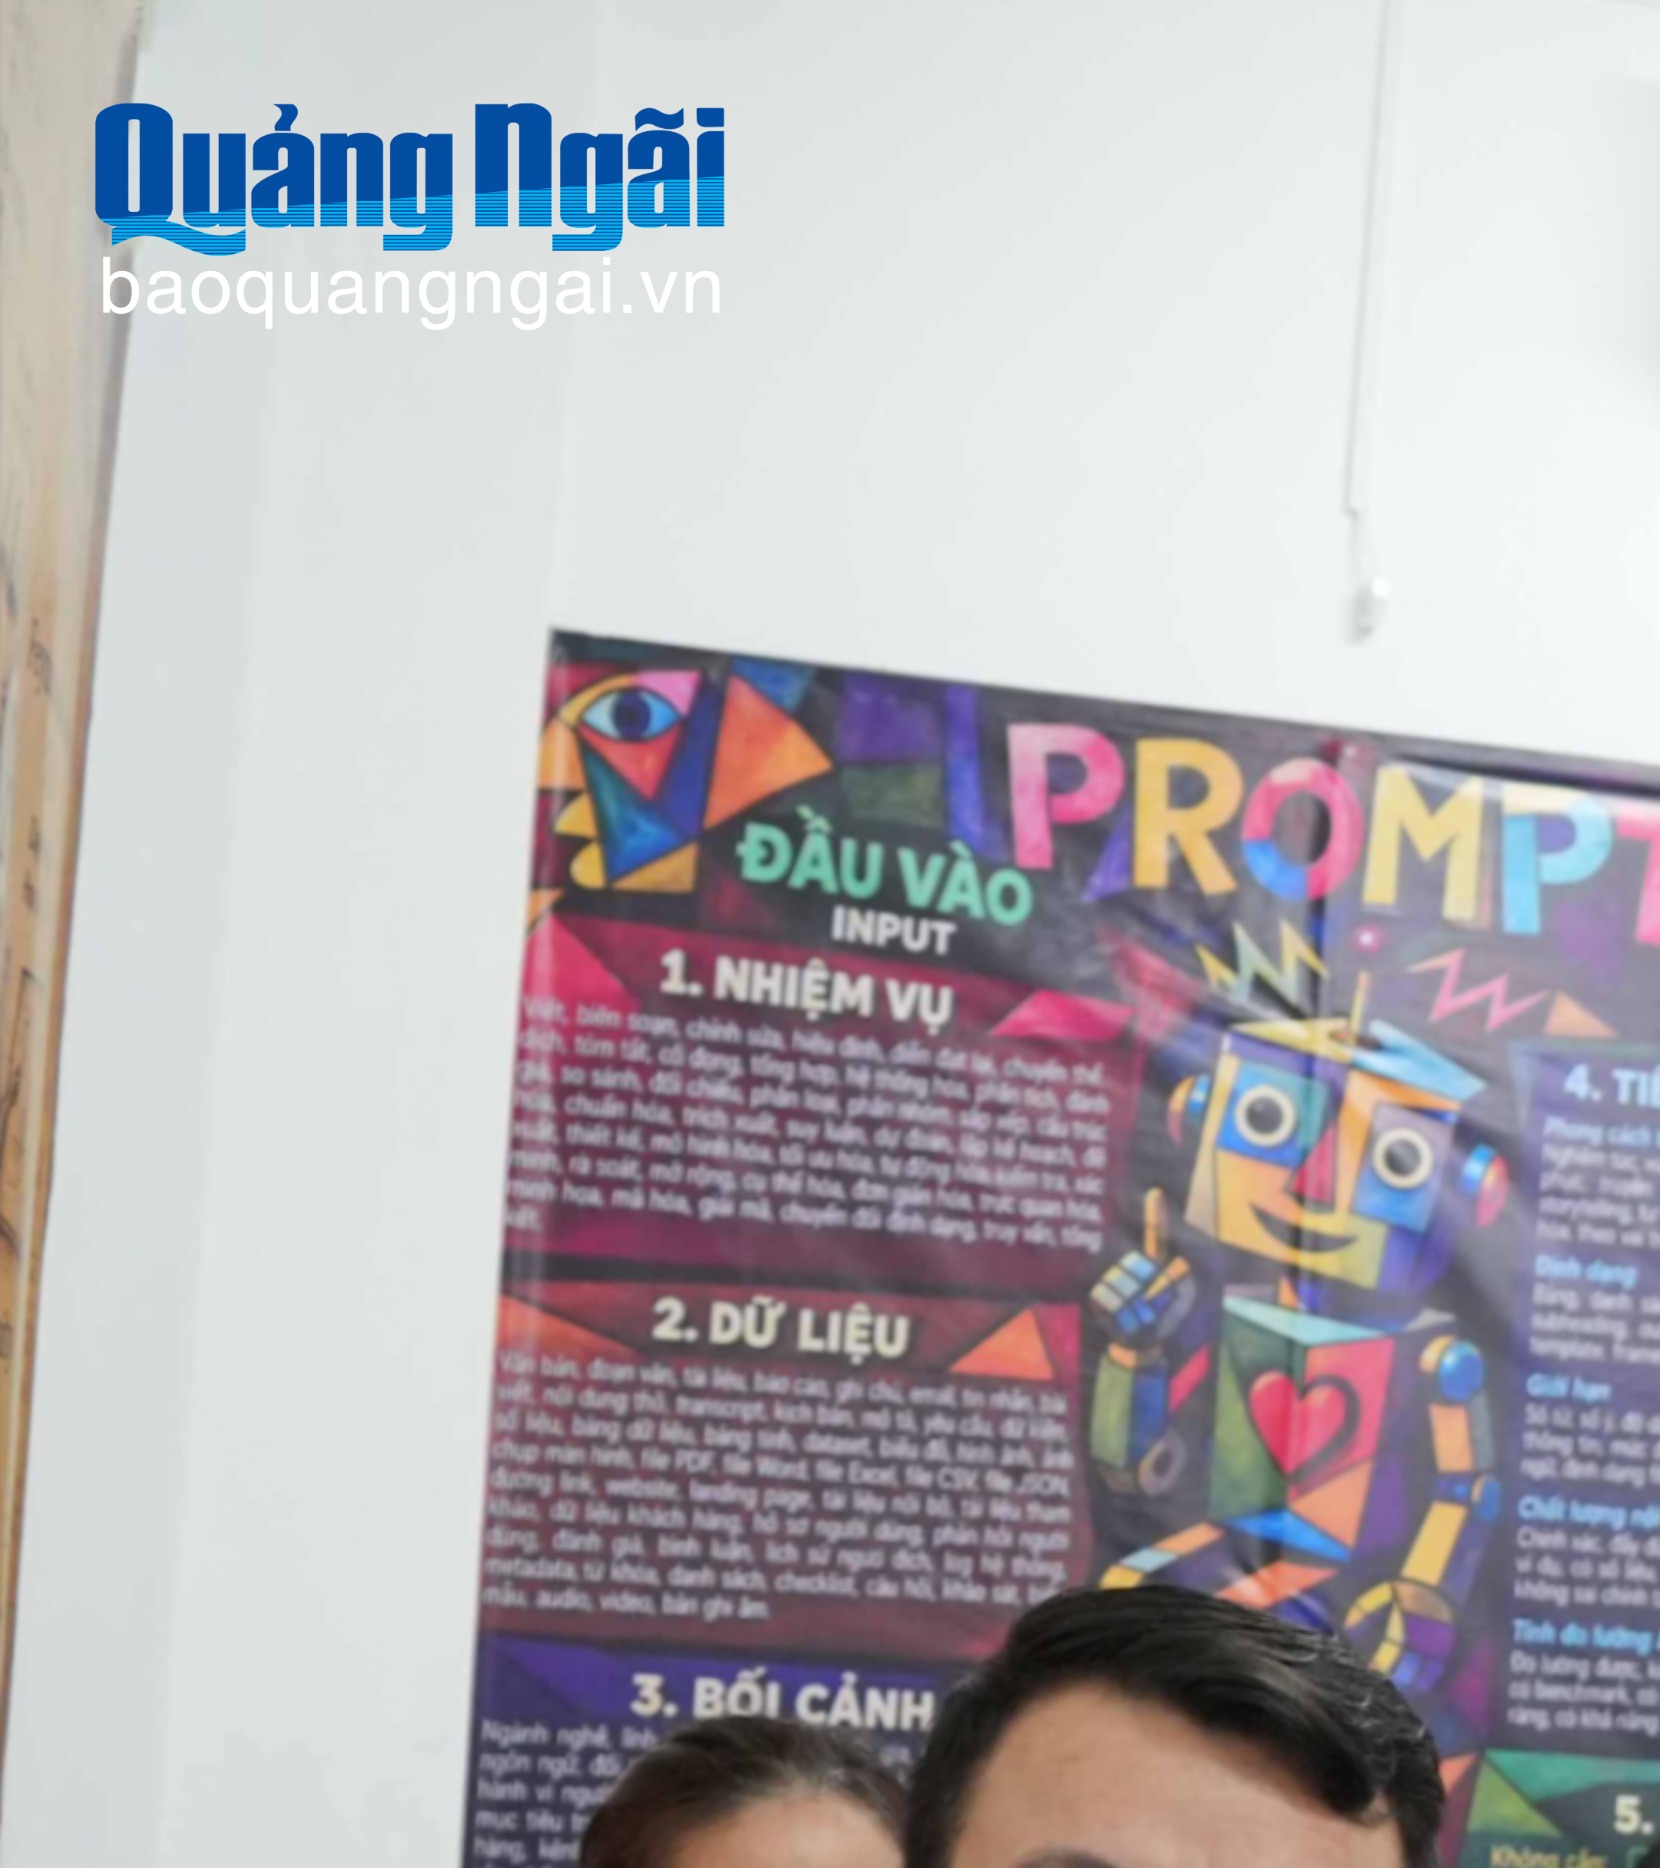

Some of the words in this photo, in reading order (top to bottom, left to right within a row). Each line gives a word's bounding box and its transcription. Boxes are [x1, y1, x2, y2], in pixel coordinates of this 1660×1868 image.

[736, 805, 884, 899] ĐẦU
[899, 841, 1034, 926] VÀO
[831, 904, 957, 956] INPUT
[660, 949, 702, 996] 1.
[715, 953, 876, 1020] NHIỆM
[885, 983, 954, 1035] VỤ
[1563, 1064, 1602, 1101] 4.
[652, 1297, 698, 1342] 2.
[708, 1295, 787, 1348] DỮ
[797, 1302, 910, 1365] LIỆU
[631, 1673, 677, 1717] 3.
[692, 1667, 780, 1720] BỐI
[794, 1672, 933, 1731] CẢNH
[1613, 1795, 1653, 1835] 5.
